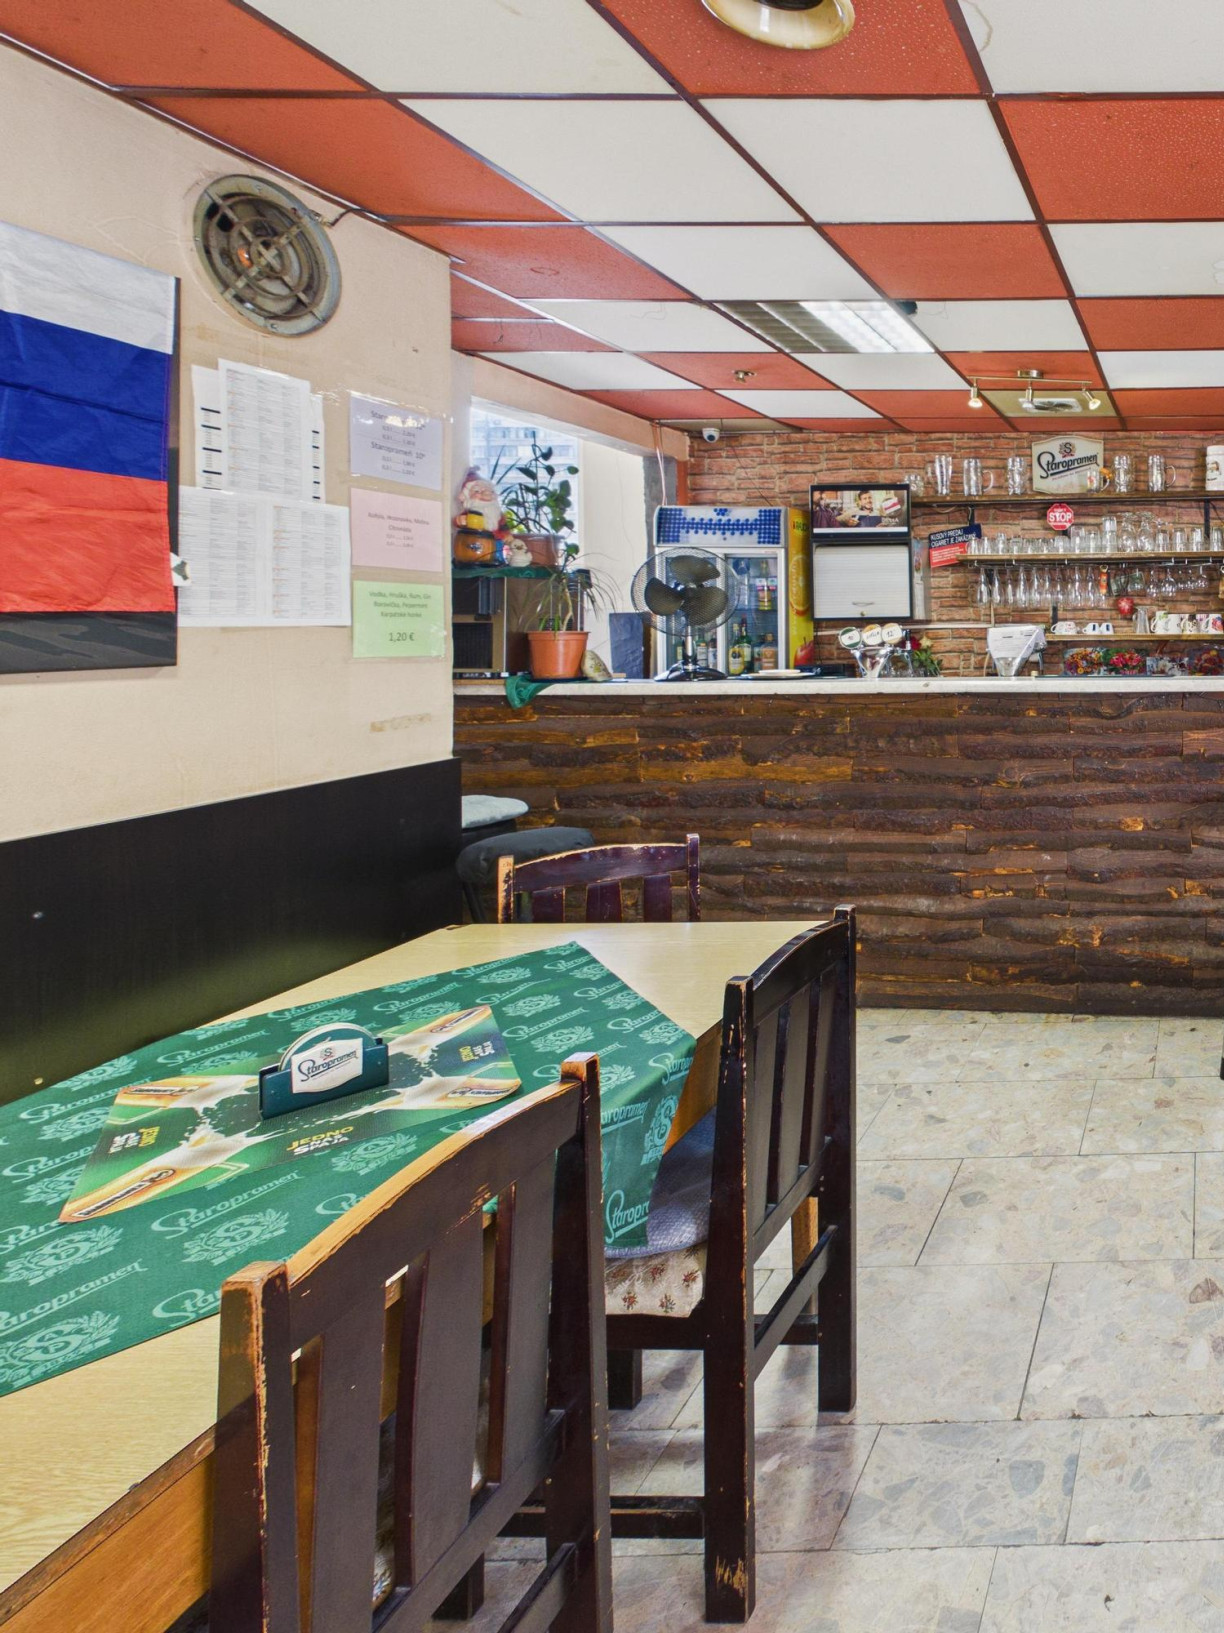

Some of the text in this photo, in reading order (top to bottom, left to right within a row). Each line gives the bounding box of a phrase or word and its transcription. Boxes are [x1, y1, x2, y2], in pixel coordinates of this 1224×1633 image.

[1037, 451, 1099, 479] Staropramen
[1049, 511, 1072, 522] STOP
[388, 631, 415, 643] 1,20 €
[502, 1006, 590, 1042] Staropramen
[297, 1050, 359, 1082] Staropramen
[286, 1126, 353, 1151] JEDNO
[151, 1170, 304, 1239] Staropramen
